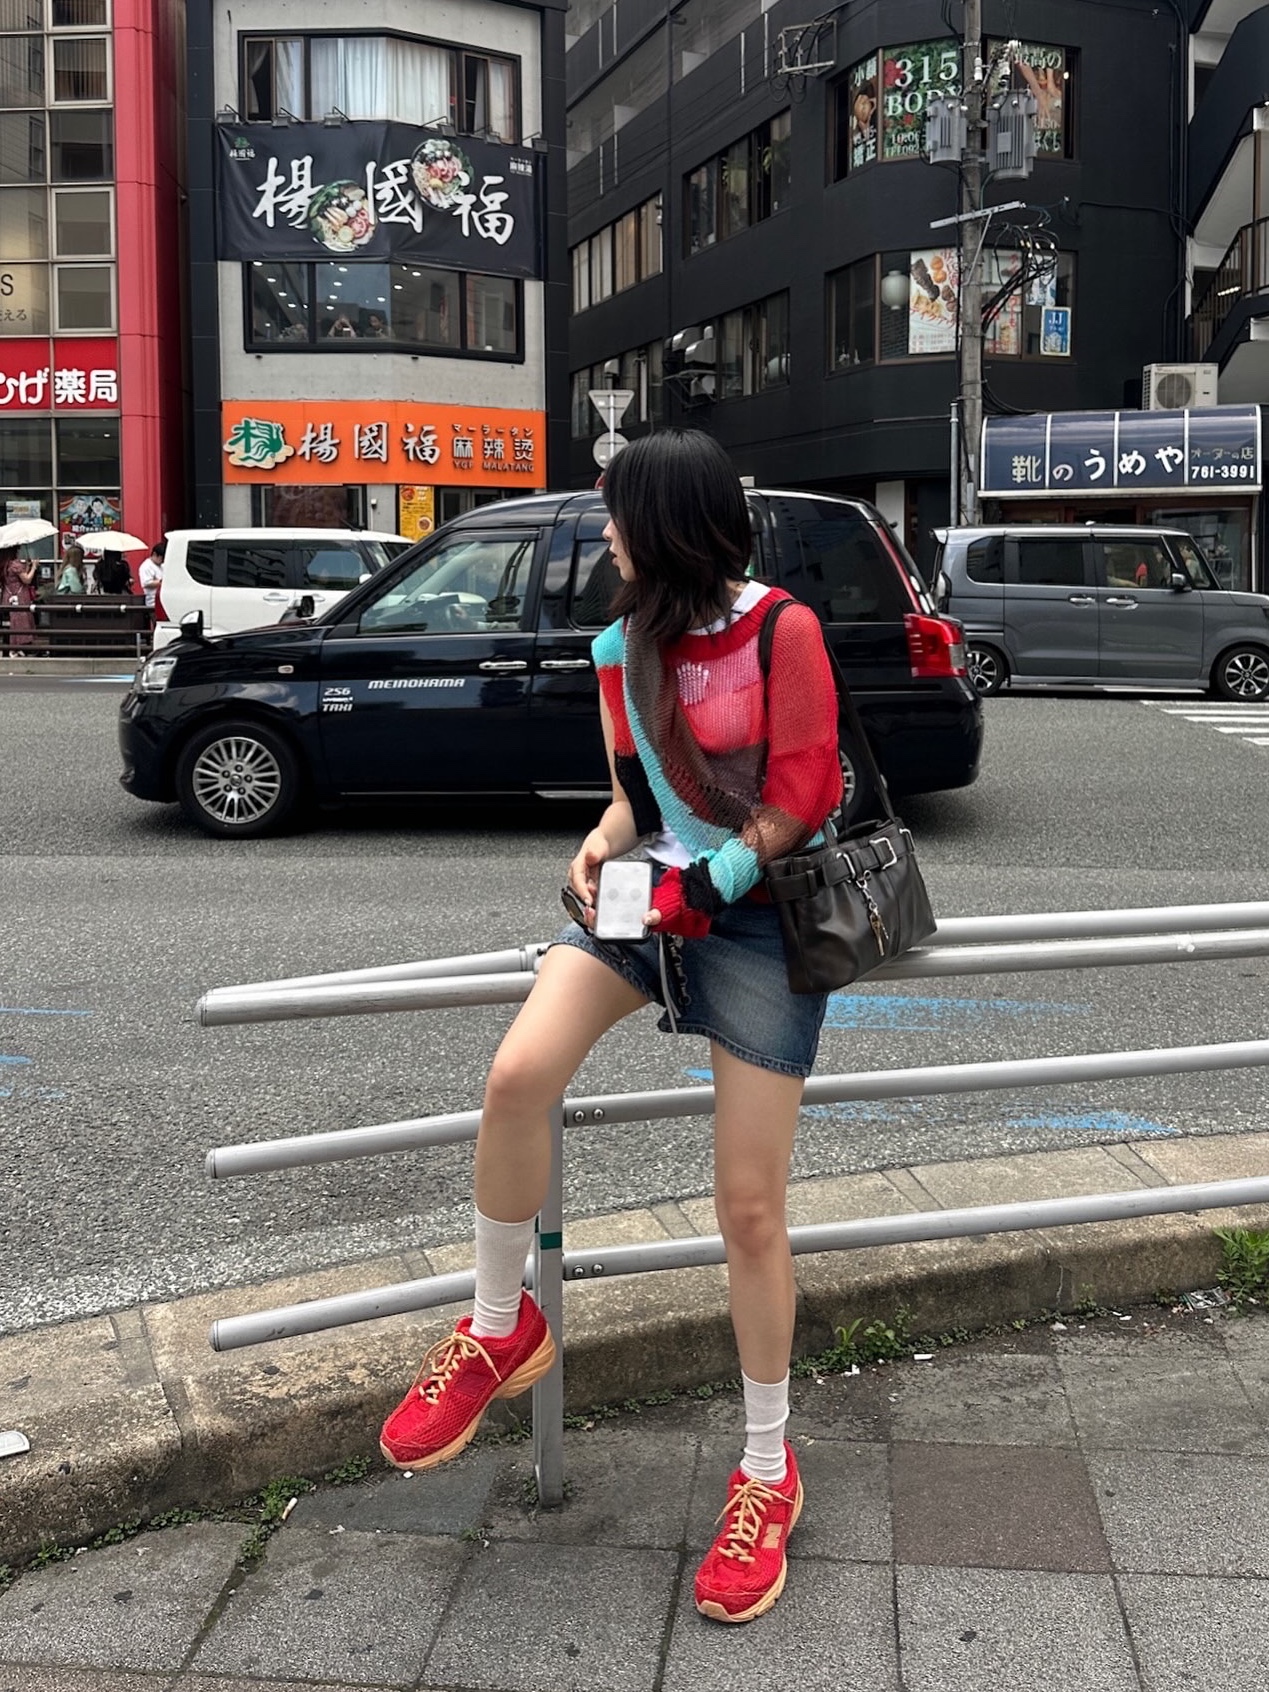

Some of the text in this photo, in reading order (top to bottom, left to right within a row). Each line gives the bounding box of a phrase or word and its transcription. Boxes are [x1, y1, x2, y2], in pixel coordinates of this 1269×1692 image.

[894, 51, 958, 87] 315
[252, 155, 514, 245] 楊國福
[0, 308, 28, 322] える
[0, 367, 118, 404] ひげ薬局
[453, 423, 534, 437] マーラータン
[298, 422, 441, 465] 楊國福
[483, 462, 535, 473] MALATANG
[1011, 446, 1184, 484] 靴のうめや
[1190, 464, 1255, 480] 761-3991
[368, 678, 465, 689] MEINOHAMA
[322, 703, 353, 712] TAXI
